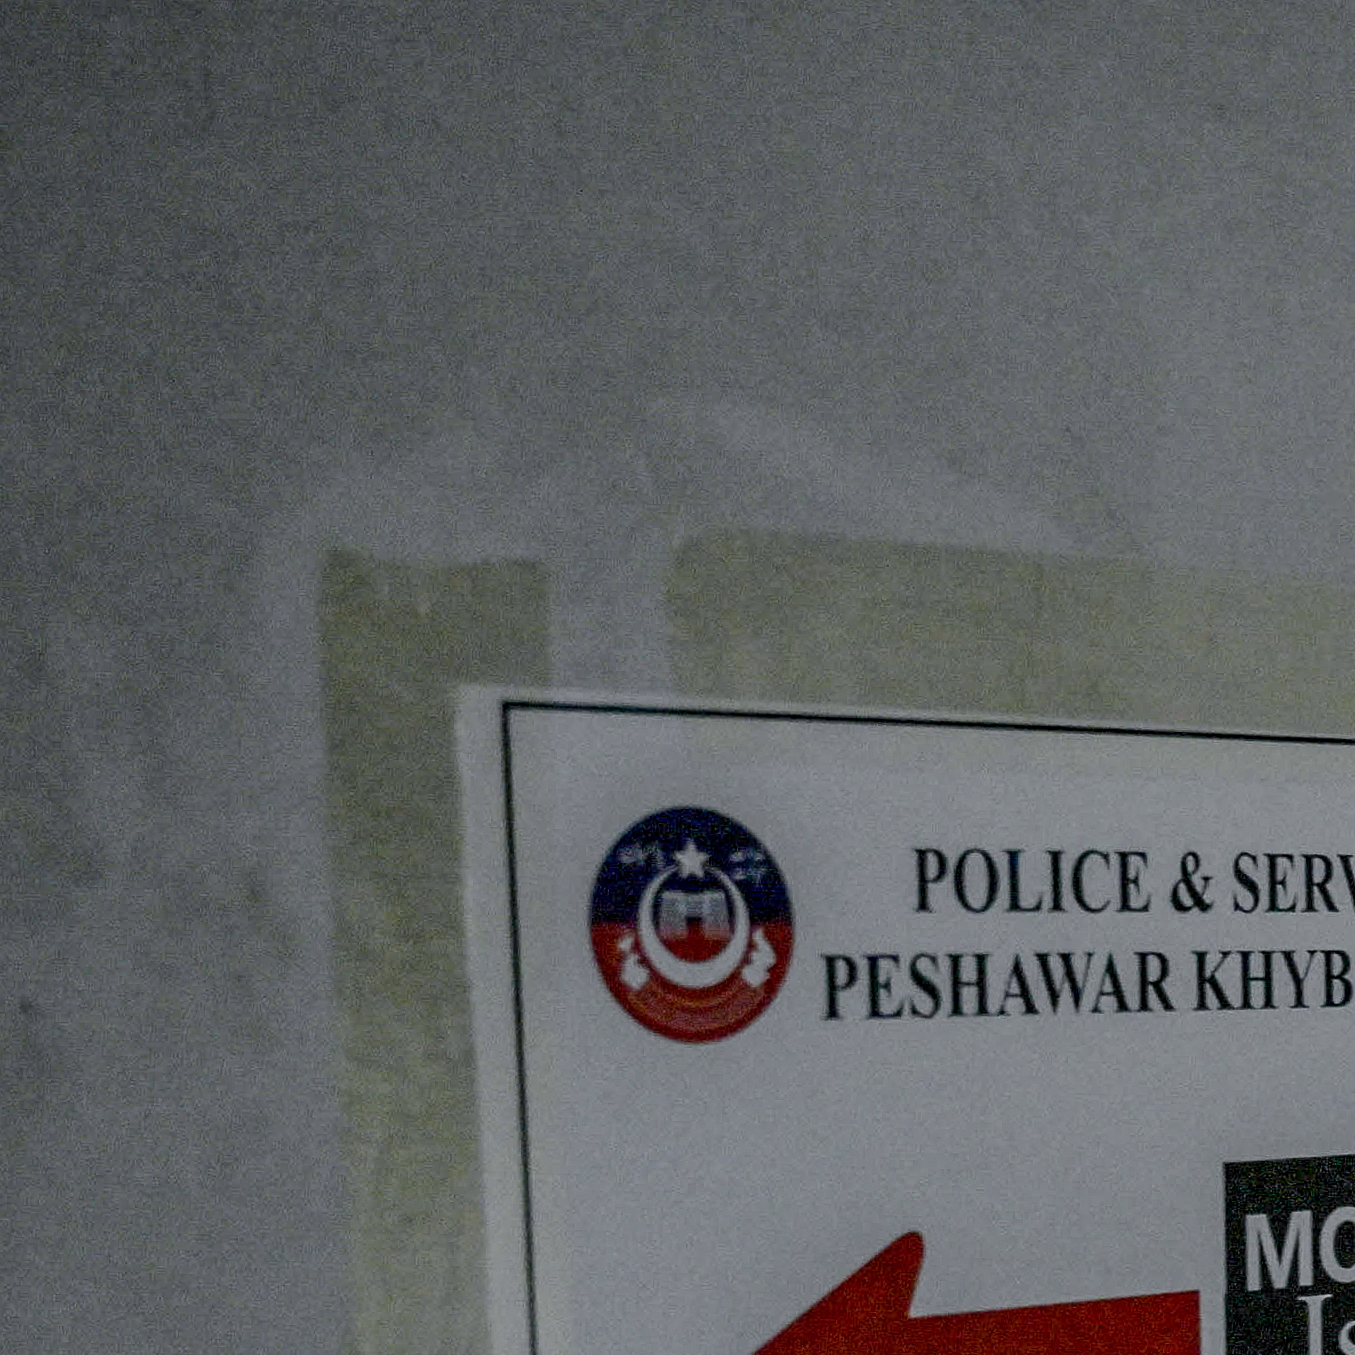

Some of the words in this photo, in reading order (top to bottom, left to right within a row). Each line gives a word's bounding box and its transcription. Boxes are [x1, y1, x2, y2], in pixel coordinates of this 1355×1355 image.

[913, 847, 1151, 914] POLICE
[1169, 850, 1214, 914] &
[821, 951, 1176, 1021] PESHAWAR
